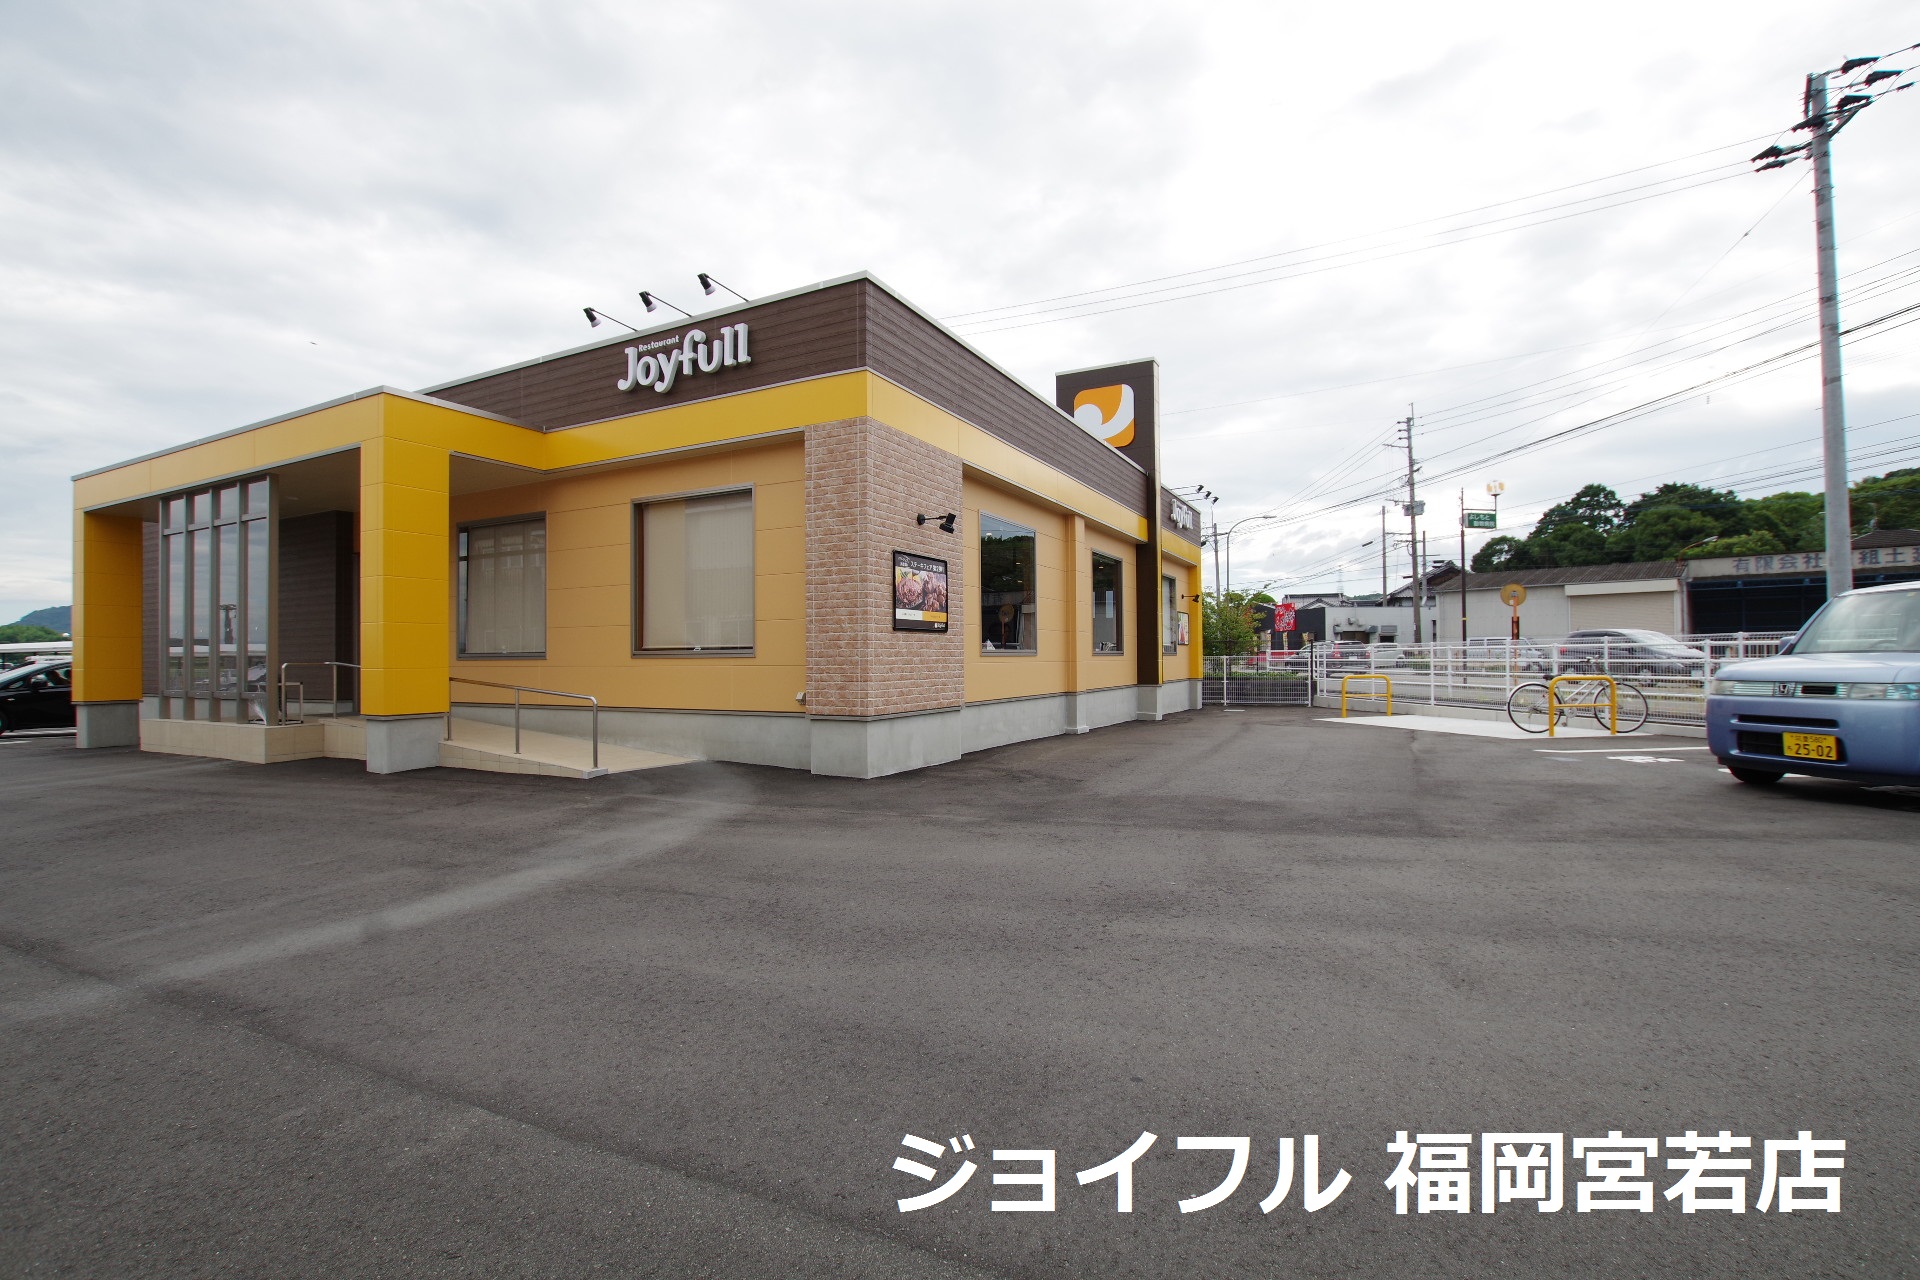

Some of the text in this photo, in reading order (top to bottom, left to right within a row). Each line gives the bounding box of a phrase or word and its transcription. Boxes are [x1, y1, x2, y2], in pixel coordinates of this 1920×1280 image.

[638, 335, 680, 352] Restaurant
[617, 323, 752, 394] Joyfull
[1794, 743, 1833, 758] 25-02
